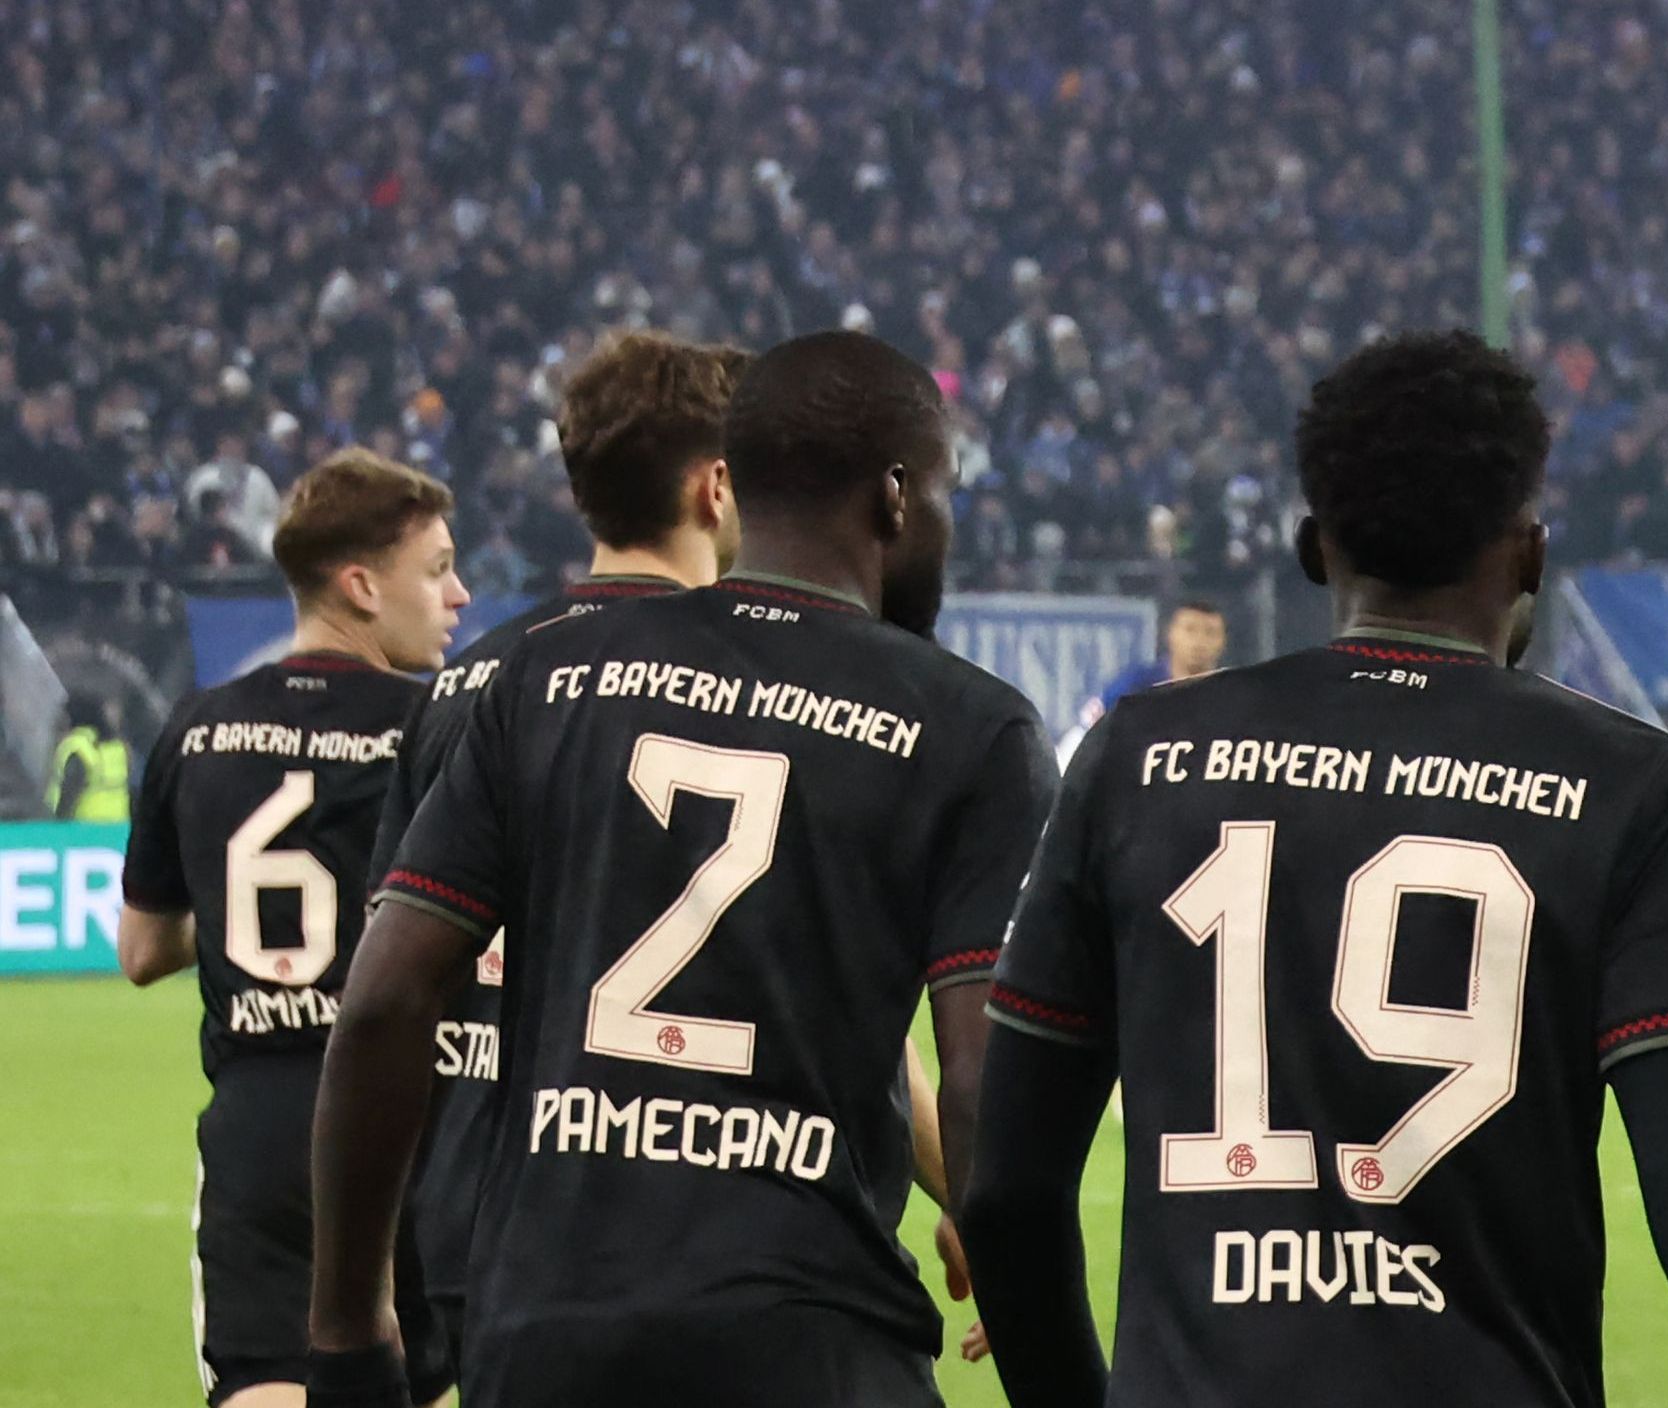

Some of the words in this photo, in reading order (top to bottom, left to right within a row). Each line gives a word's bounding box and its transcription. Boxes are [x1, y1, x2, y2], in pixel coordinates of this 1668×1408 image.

[733, 602, 801, 624] FCBM
[432, 665, 466, 701] FC
[545, 664, 592, 704] FC
[596, 660, 743, 716] BAYERN
[747, 678, 923, 760] MÜNCHEN
[182, 725, 209, 757] FC
[212, 721, 302, 758] BAYERN
[1142, 741, 1194, 786] FC
[1204, 739, 1372, 794] BAYERN
[1384, 754, 1588, 821] MÜNCHEN
[0, 846, 126, 951] ER
[225, 770, 337, 986] 6
[584, 732, 791, 1077] 2
[1158, 820, 1536, 1204] 19
[1212, 1229, 1447, 1314] DAVIES
